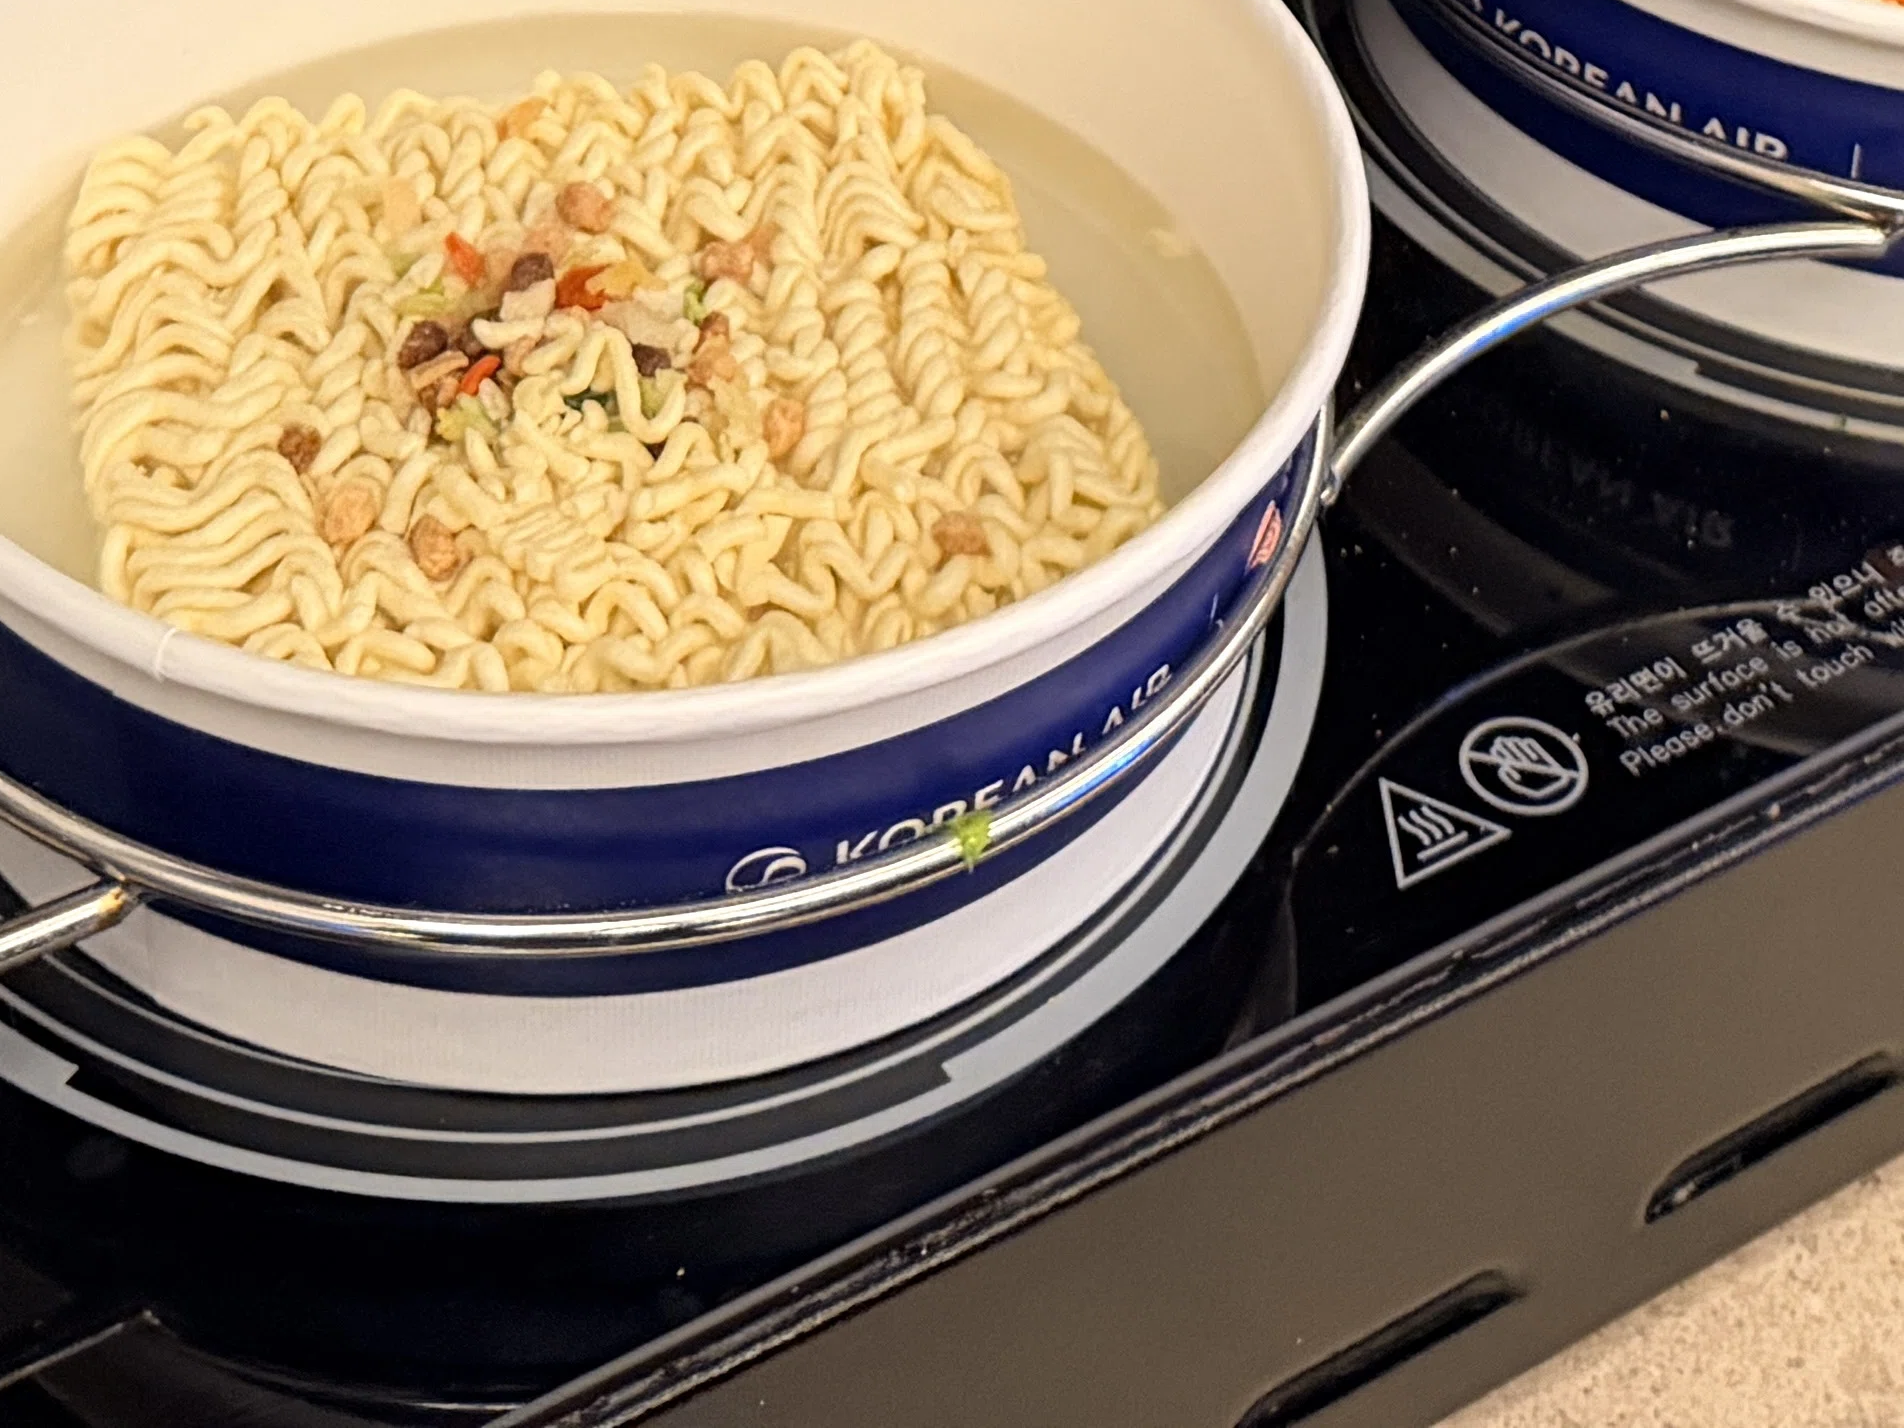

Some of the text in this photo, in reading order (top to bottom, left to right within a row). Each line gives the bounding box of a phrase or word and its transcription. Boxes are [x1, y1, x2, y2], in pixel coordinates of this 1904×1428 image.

[1606, 707, 1665, 739] The
[1670, 656, 1770, 712] surface
[1771, 640, 1803, 662] is
[1795, 643, 1875, 691] touch
